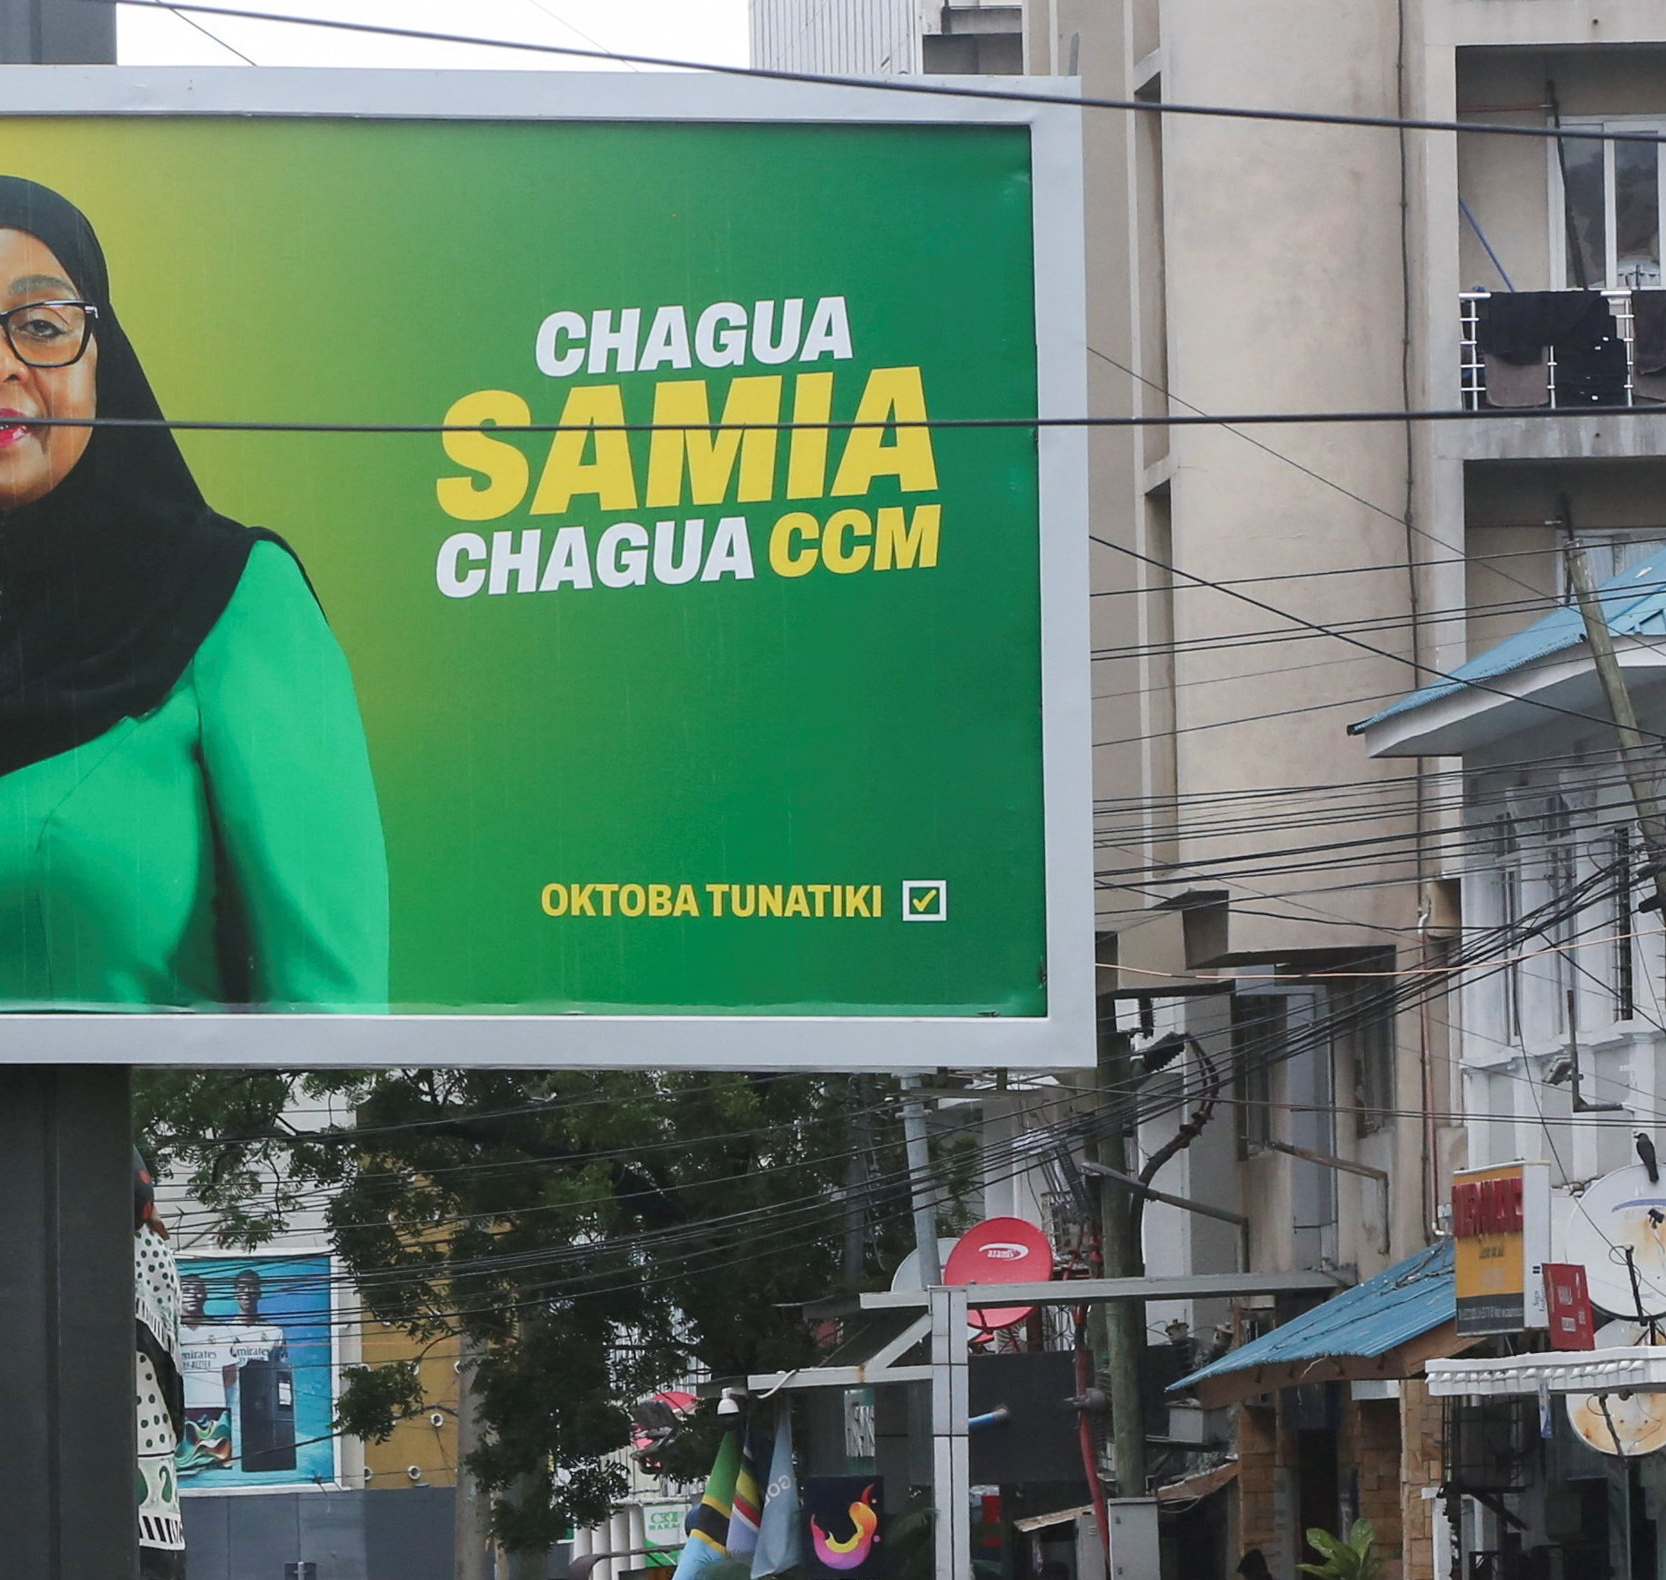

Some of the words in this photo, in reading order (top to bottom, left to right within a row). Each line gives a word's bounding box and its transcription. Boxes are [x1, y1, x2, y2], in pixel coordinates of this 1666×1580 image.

[535, 296, 853, 377] CHAGUA
[436, 366, 939, 521] SAMIA
[436, 516, 755, 598] CHAGUA
[769, 504, 942, 577] CCM
[540, 883, 700, 917] OKTOBA
[706, 884, 883, 918] TUNATIKI
